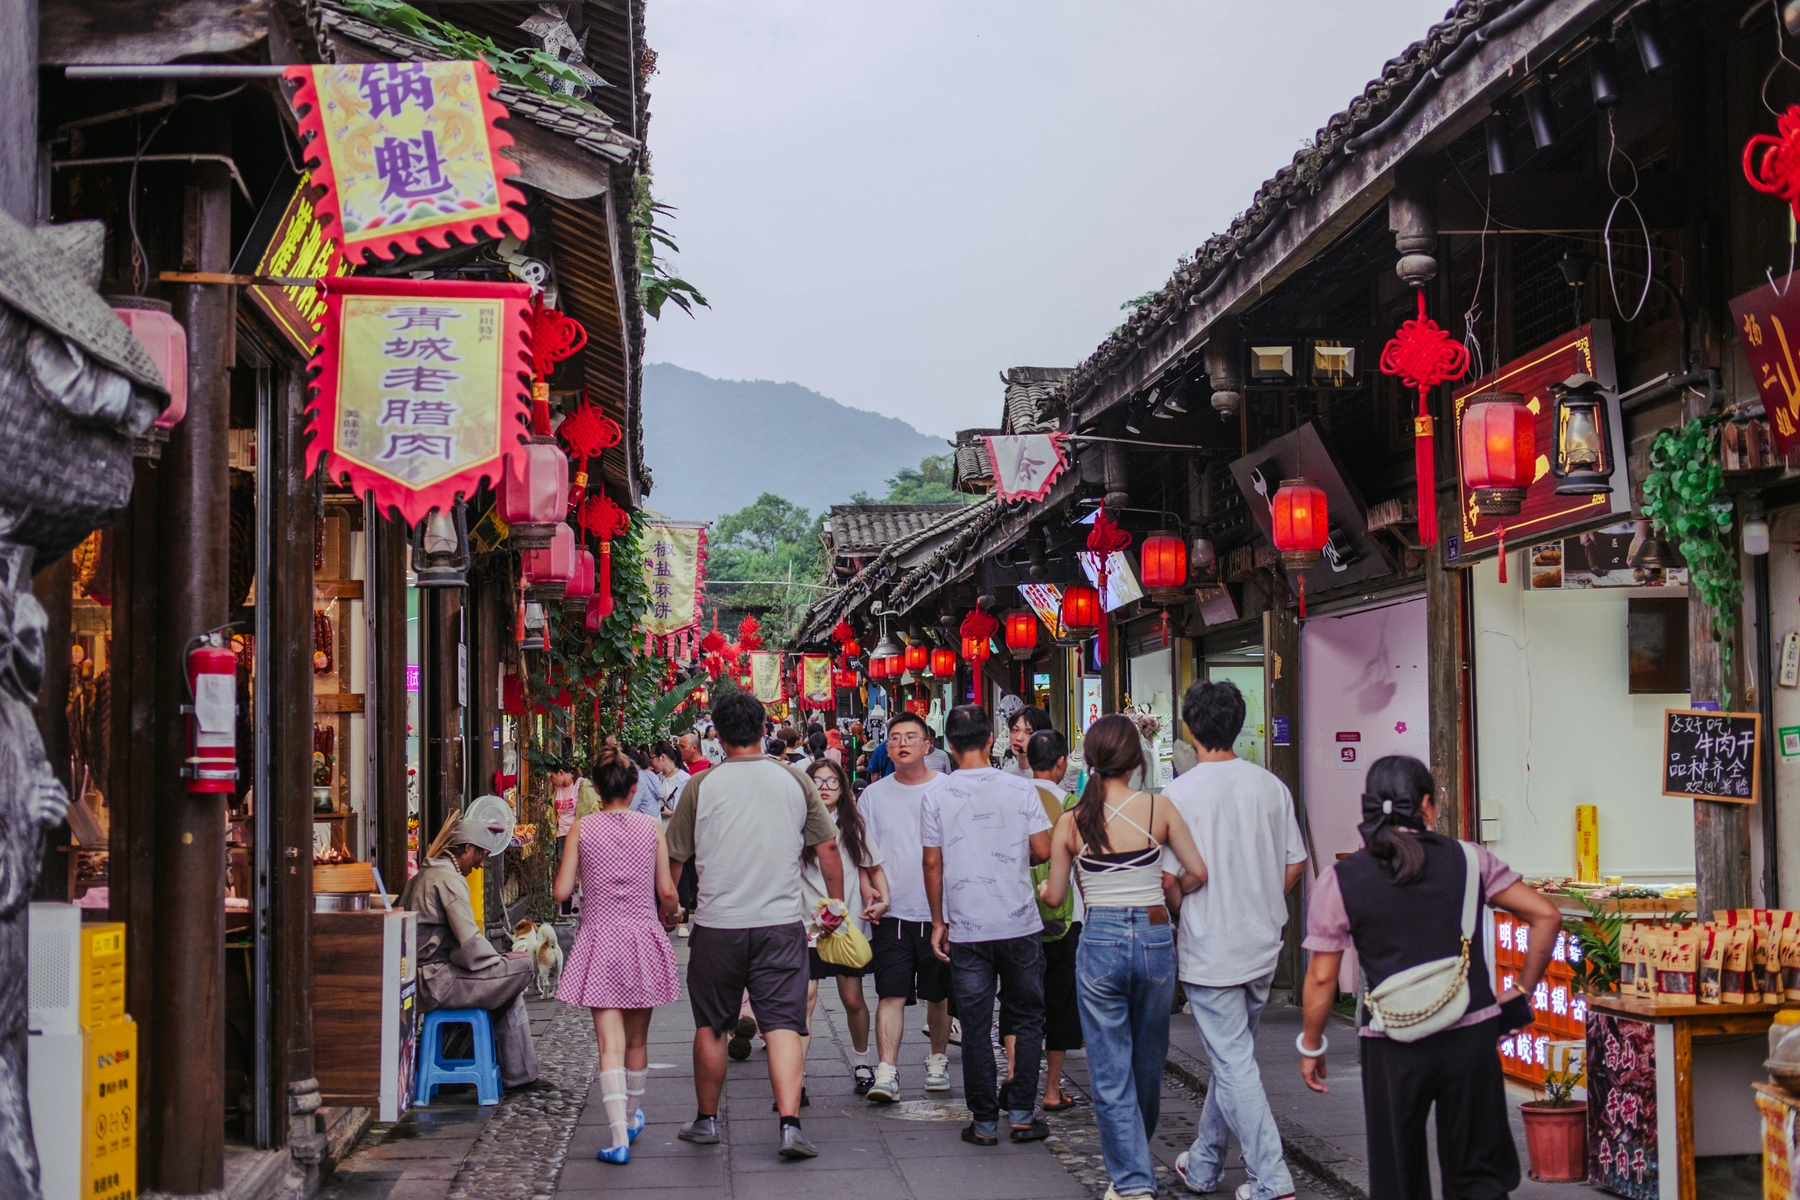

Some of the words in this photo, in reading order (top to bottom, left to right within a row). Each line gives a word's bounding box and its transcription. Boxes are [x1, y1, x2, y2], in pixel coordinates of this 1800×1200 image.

[358, 63, 453, 204] 锅魁
[478, 308, 494, 343] 四川特产
[381, 306, 463, 460] 青城老腊肉
[653, 540, 676, 619] 椒盐麻饼
[1695, 731, 1755, 760] 牛肉干
[1669, 753, 1745, 782] 品种齐全
[1685, 777, 1749, 795] 欢迎光临
[1606, 1034, 1636, 1071] 高山
[1606, 1088, 1638, 1129] 手撕
[1599, 1138, 1647, 1184] 牛肉干
